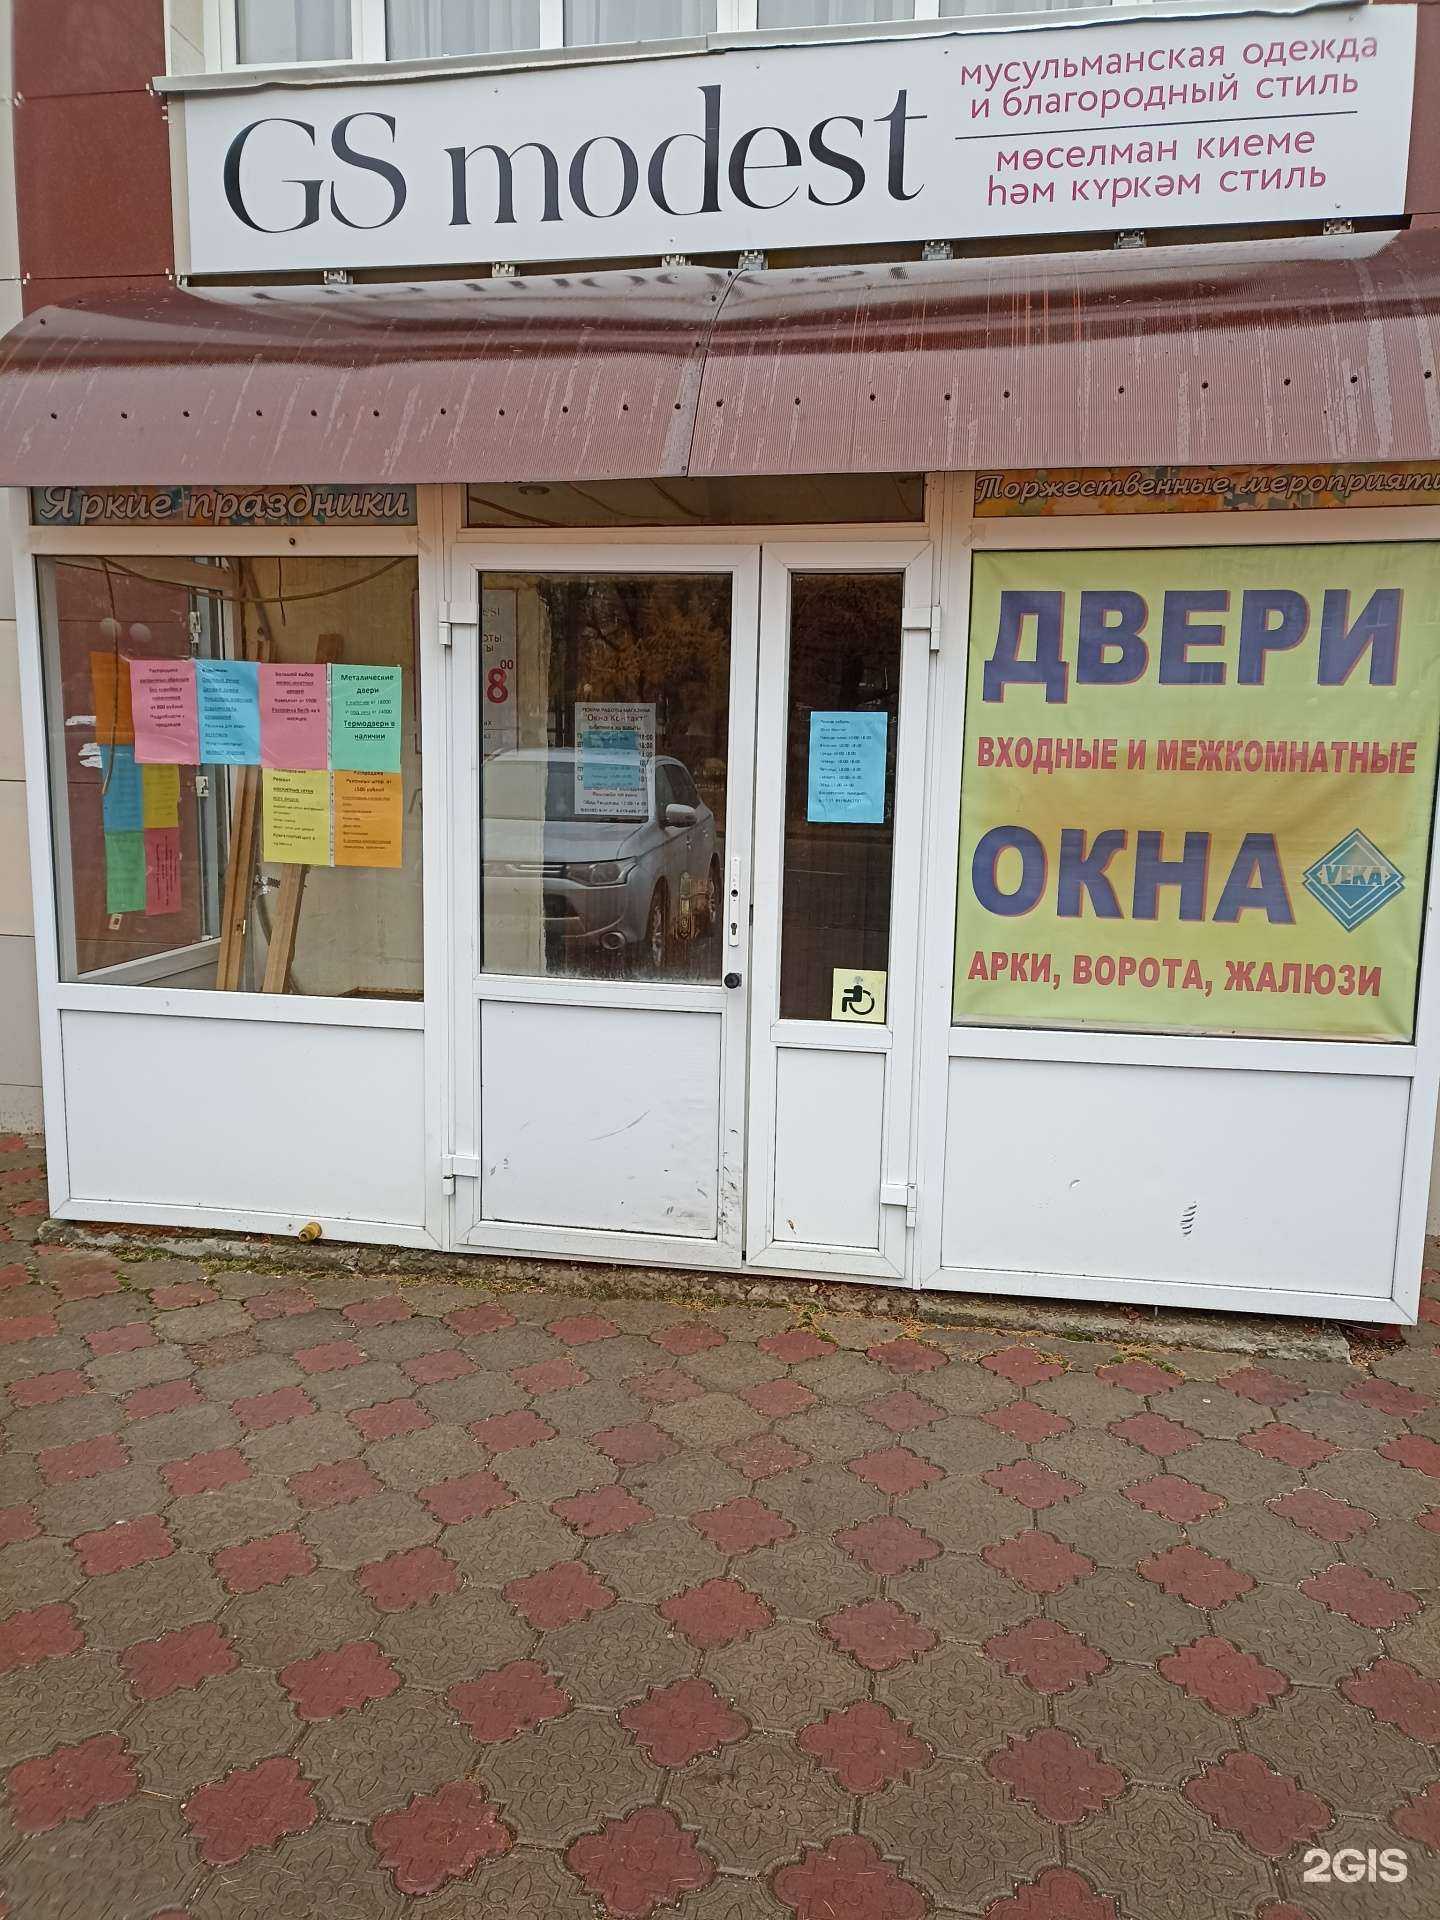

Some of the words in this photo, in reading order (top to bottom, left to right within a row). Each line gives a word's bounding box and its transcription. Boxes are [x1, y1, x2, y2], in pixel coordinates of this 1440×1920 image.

[960, 47, 1226, 92] мусульманская
[1242, 36, 1379, 69] одежда
[970, 98, 991, 118] и
[1002, 74, 1239, 119] благородный
[1255, 74, 1360, 101] стиль
[223, 111, 408, 233] GS
[443, 85, 928, 226] modest
[996, 139, 1178, 172] мөселман
[1196, 130, 1316, 159] киеме
[1071, 174, 1202, 207] күркәм
[1218, 164, 1328, 192] стиль
[39, 486, 172, 525] Яркие
[187, 486, 411, 525] праздники
[976, 471, 1232, 504] Торжественные
[981, 588, 1405, 704] ДВЕРИ
[976, 736, 1119, 774] ВХОДНЫЕ
[1127, 739, 1147, 770] И
[1156, 738, 1418, 774] МЕЖКОМНАТНЫЕ
[970, 824, 1297, 925] ОКНА
[1320, 863, 1389, 887] VEKA
[967, 950, 1061, 990] АРКИ,
[1072, 955, 1214, 998] ВОРОТА,
[1223, 960, 1383, 997] ЖАЛЮЗИ
